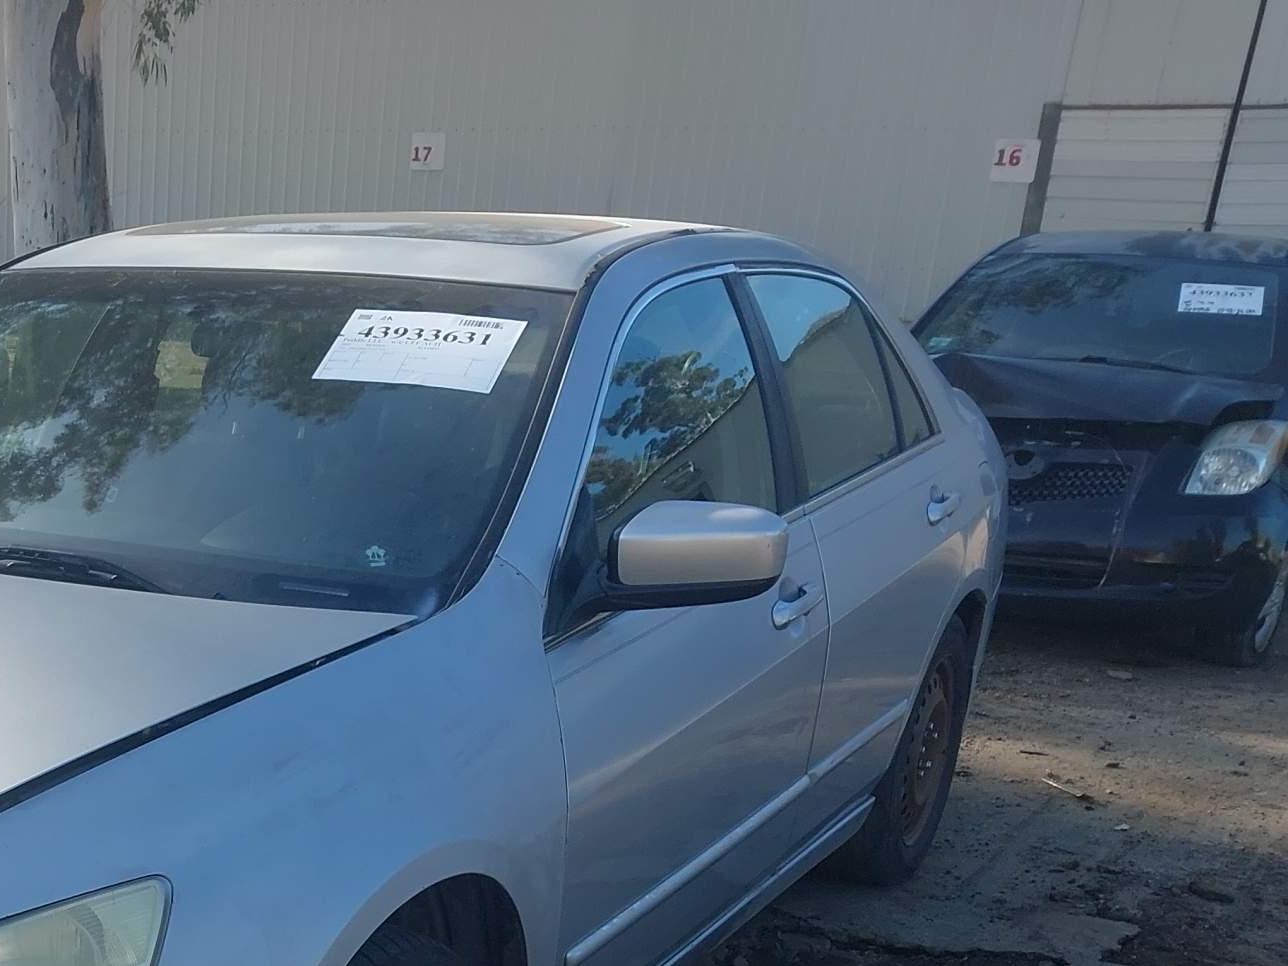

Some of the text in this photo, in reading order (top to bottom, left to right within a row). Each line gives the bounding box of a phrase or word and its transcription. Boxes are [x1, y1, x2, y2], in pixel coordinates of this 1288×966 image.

[412, 146, 432, 161] 17
[993, 149, 1022, 167] 16
[358, 325, 494, 346] 43933631
